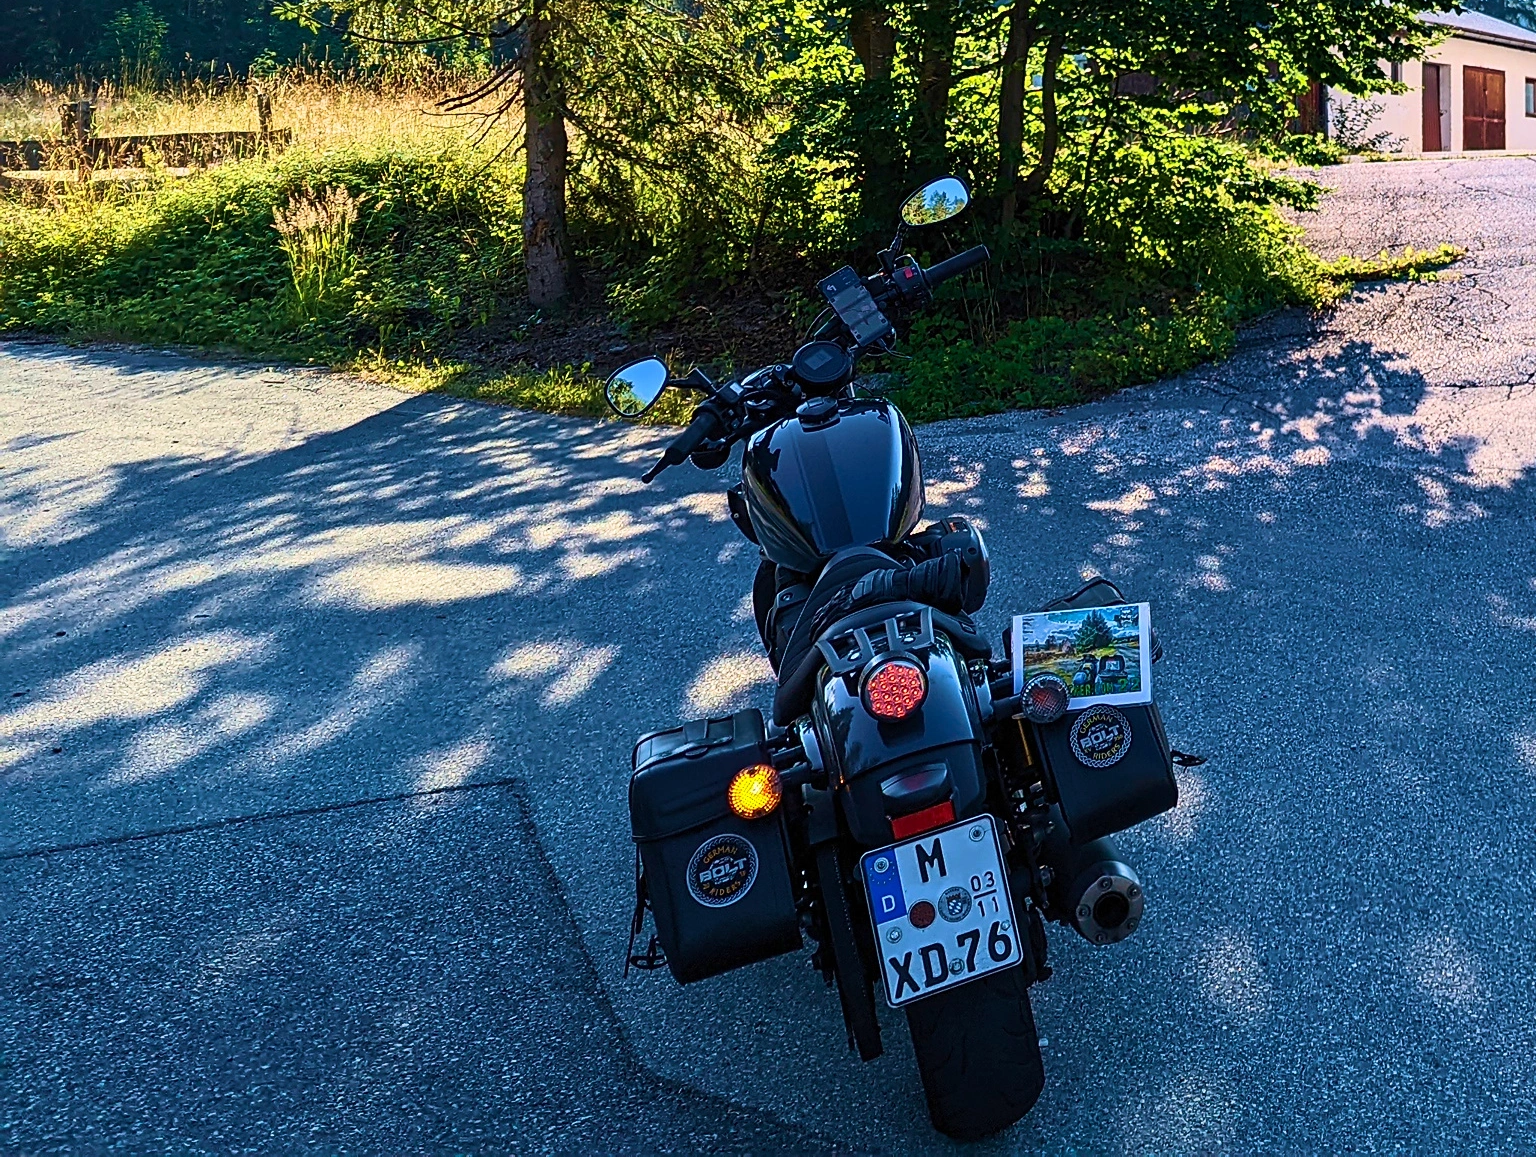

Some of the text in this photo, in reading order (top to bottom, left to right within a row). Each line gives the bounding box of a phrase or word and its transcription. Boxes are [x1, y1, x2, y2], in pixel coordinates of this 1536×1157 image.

[1079, 714, 1113, 734] GERMAN
[1080, 724, 1120, 749] BOLT
[1093, 743, 1121, 760] RIDERS
[703, 845, 738, 864] GERMAN
[915, 837, 947, 883] M
[699, 857, 747, 883] BOLT
[709, 881, 741, 897] RIDERS
[970, 871, 995, 893] 03
[881, 894, 896, 913] D
[976, 896, 999, 918] 11
[888, 920, 1012, 999] XD 76
